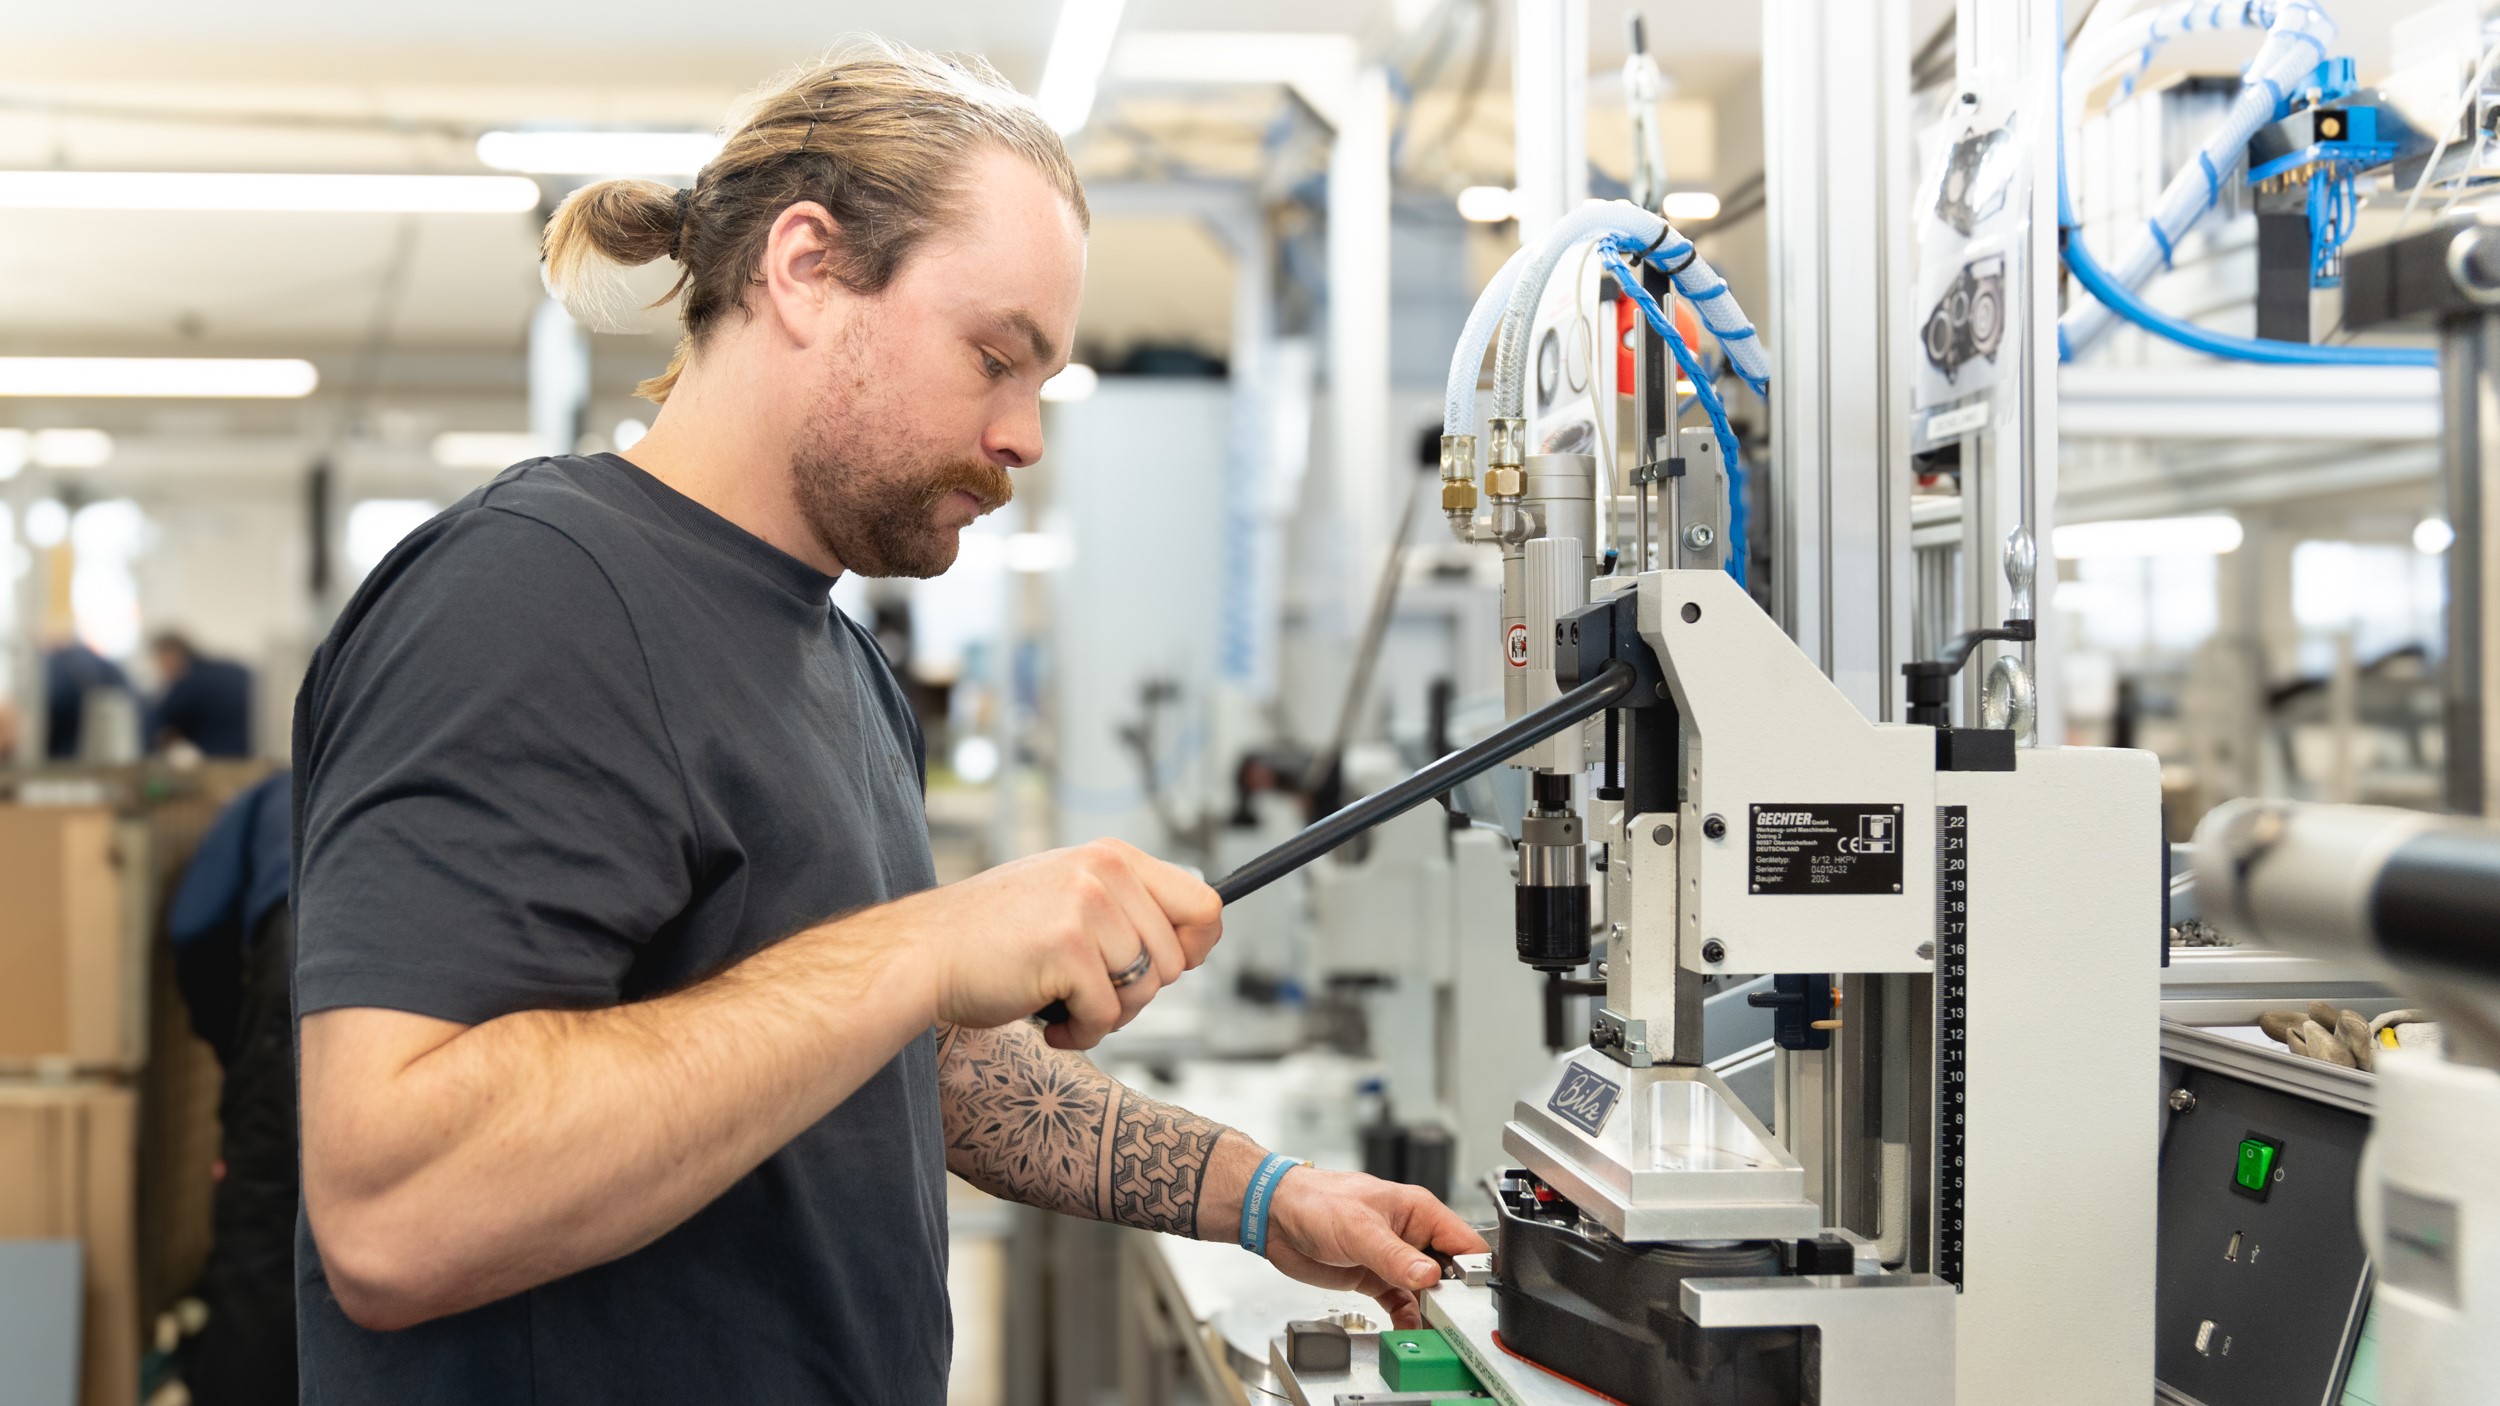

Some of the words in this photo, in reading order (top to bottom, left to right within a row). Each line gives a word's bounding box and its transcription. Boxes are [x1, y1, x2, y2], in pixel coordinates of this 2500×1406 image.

[1757, 813, 1812, 825] GECHTER
[1950, 817, 1965, 827] 22
[1950, 838, 1964, 848] 21
[1755, 856, 1791, 865] Gerätetyp:
[1811, 856, 1830, 864] 8/12
[1834, 856, 1857, 864] HKPV
[1950, 859, 1965, 870] 20
[1811, 866, 1848, 874] 04012432
[1755, 875, 1784, 884] Baujahr:
[1811, 875, 1830, 883] 2024
[1950, 881, 1964, 891] 19
[1950, 902, 1964, 912] 18
[1950, 923, 1964, 933] 17
[1950, 944, 1964, 954] 16
[1950, 966, 1964, 976] 15
[1950, 987, 1964, 997] 14
[1950, 1008, 1964, 1018] 13
[1950, 1029, 1964, 1039] 12
[1950, 1050, 1964, 1060] 11
[1950, 1071, 1964, 1082] 10
[1955, 1093, 1963, 1103] 9
[1955, 1114, 1963, 1124] 8
[1955, 1135, 1963, 1145] 7
[1955, 1156, 1963, 1166] 6
[1955, 1177, 1963, 1188] 5
[1250, 1185, 1265, 1214] WASSER
[1258, 1172, 1271, 1186] MIT
[1954, 1199, 1962, 1209] 4
[1954, 1220, 1962, 1230] 3
[1954, 1241, 1962, 1251] 2
[1954, 1262, 1960, 1272] 1
